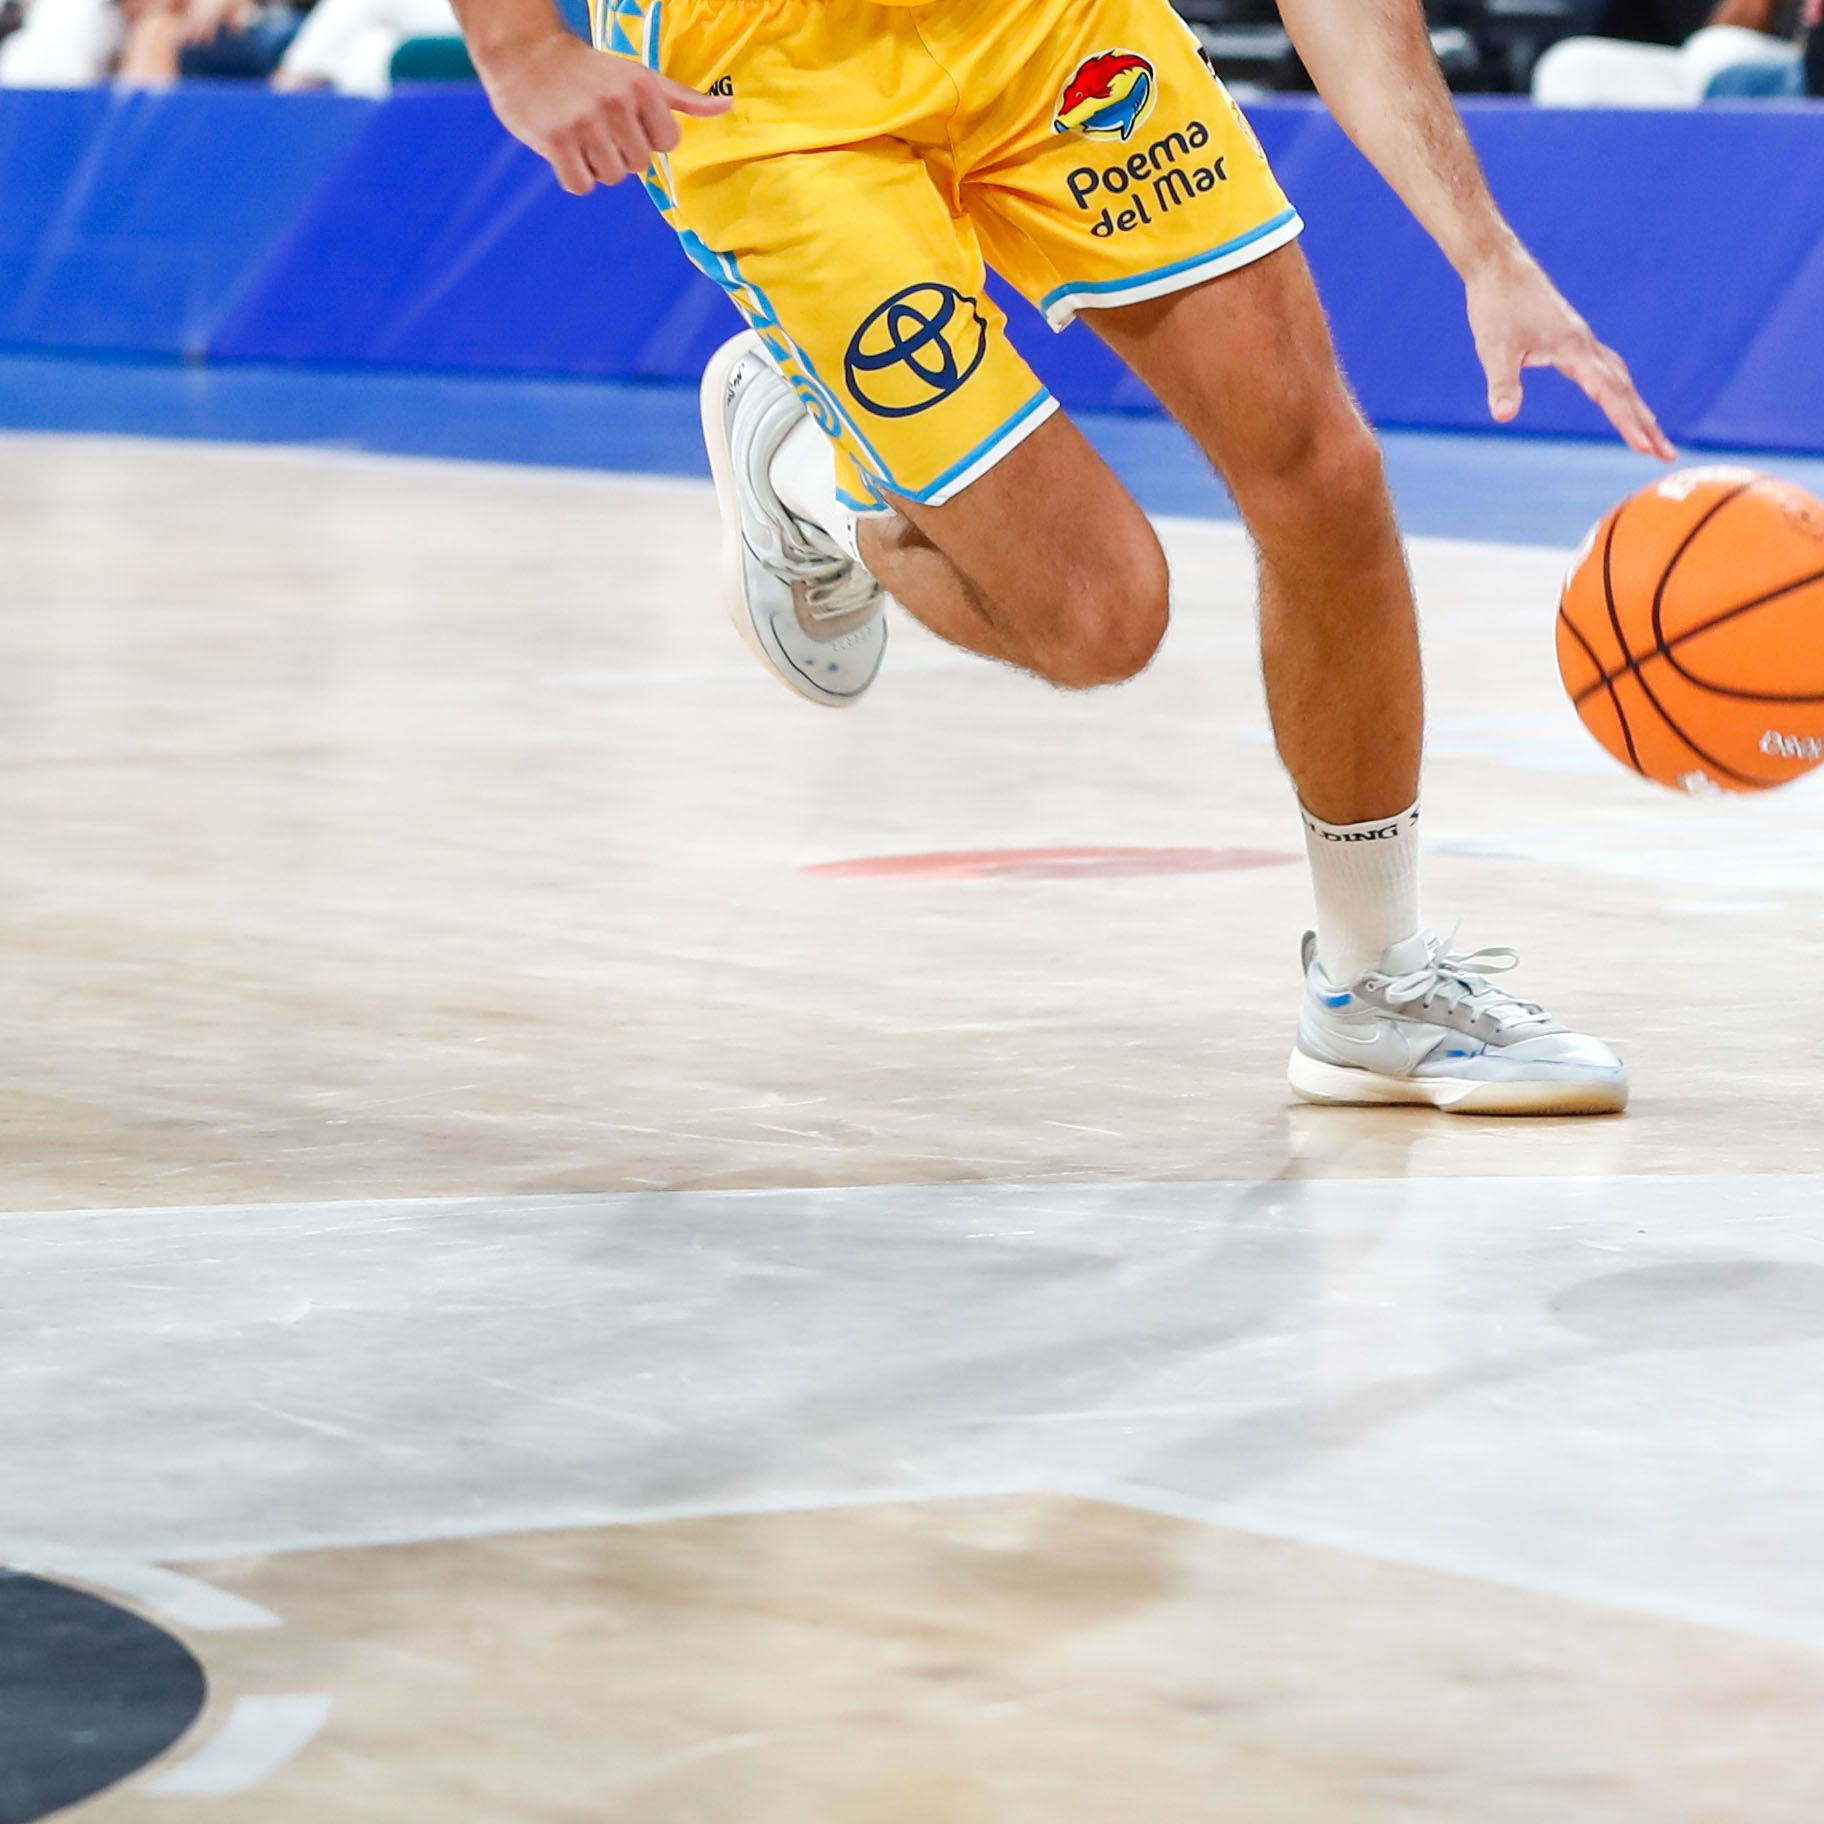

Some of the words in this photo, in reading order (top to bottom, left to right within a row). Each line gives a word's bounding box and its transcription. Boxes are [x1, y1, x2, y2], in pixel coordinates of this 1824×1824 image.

[1066, 121, 1209, 210] Poema
[1090, 193, 1152, 238] del
[1152, 156, 1228, 212] Mar
